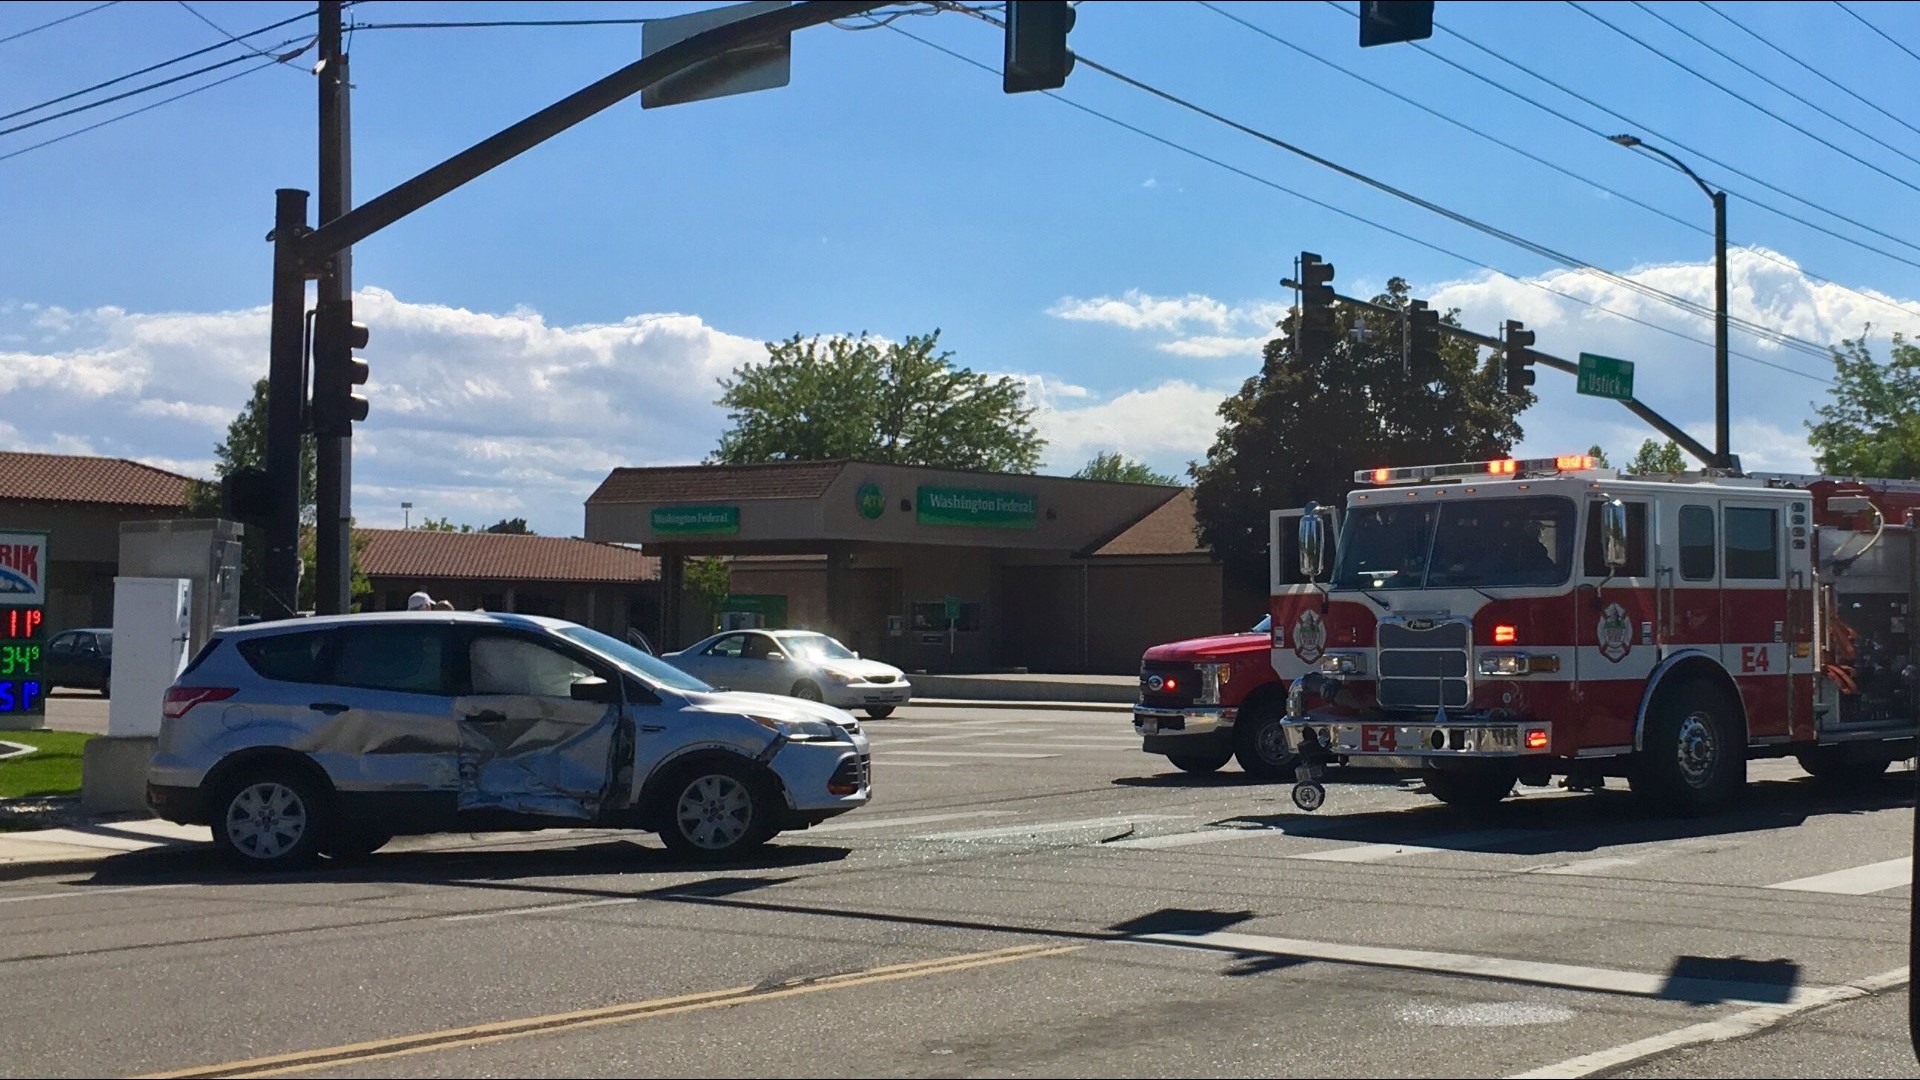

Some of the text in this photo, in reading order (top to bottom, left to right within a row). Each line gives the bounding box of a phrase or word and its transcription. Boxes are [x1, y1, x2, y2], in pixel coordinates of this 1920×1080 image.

[1588, 373, 1621, 395] Ustick
[929, 493, 1034, 513] Washington Federal
[1741, 646, 1769, 672] E4
[1361, 725, 1397, 752] E4
